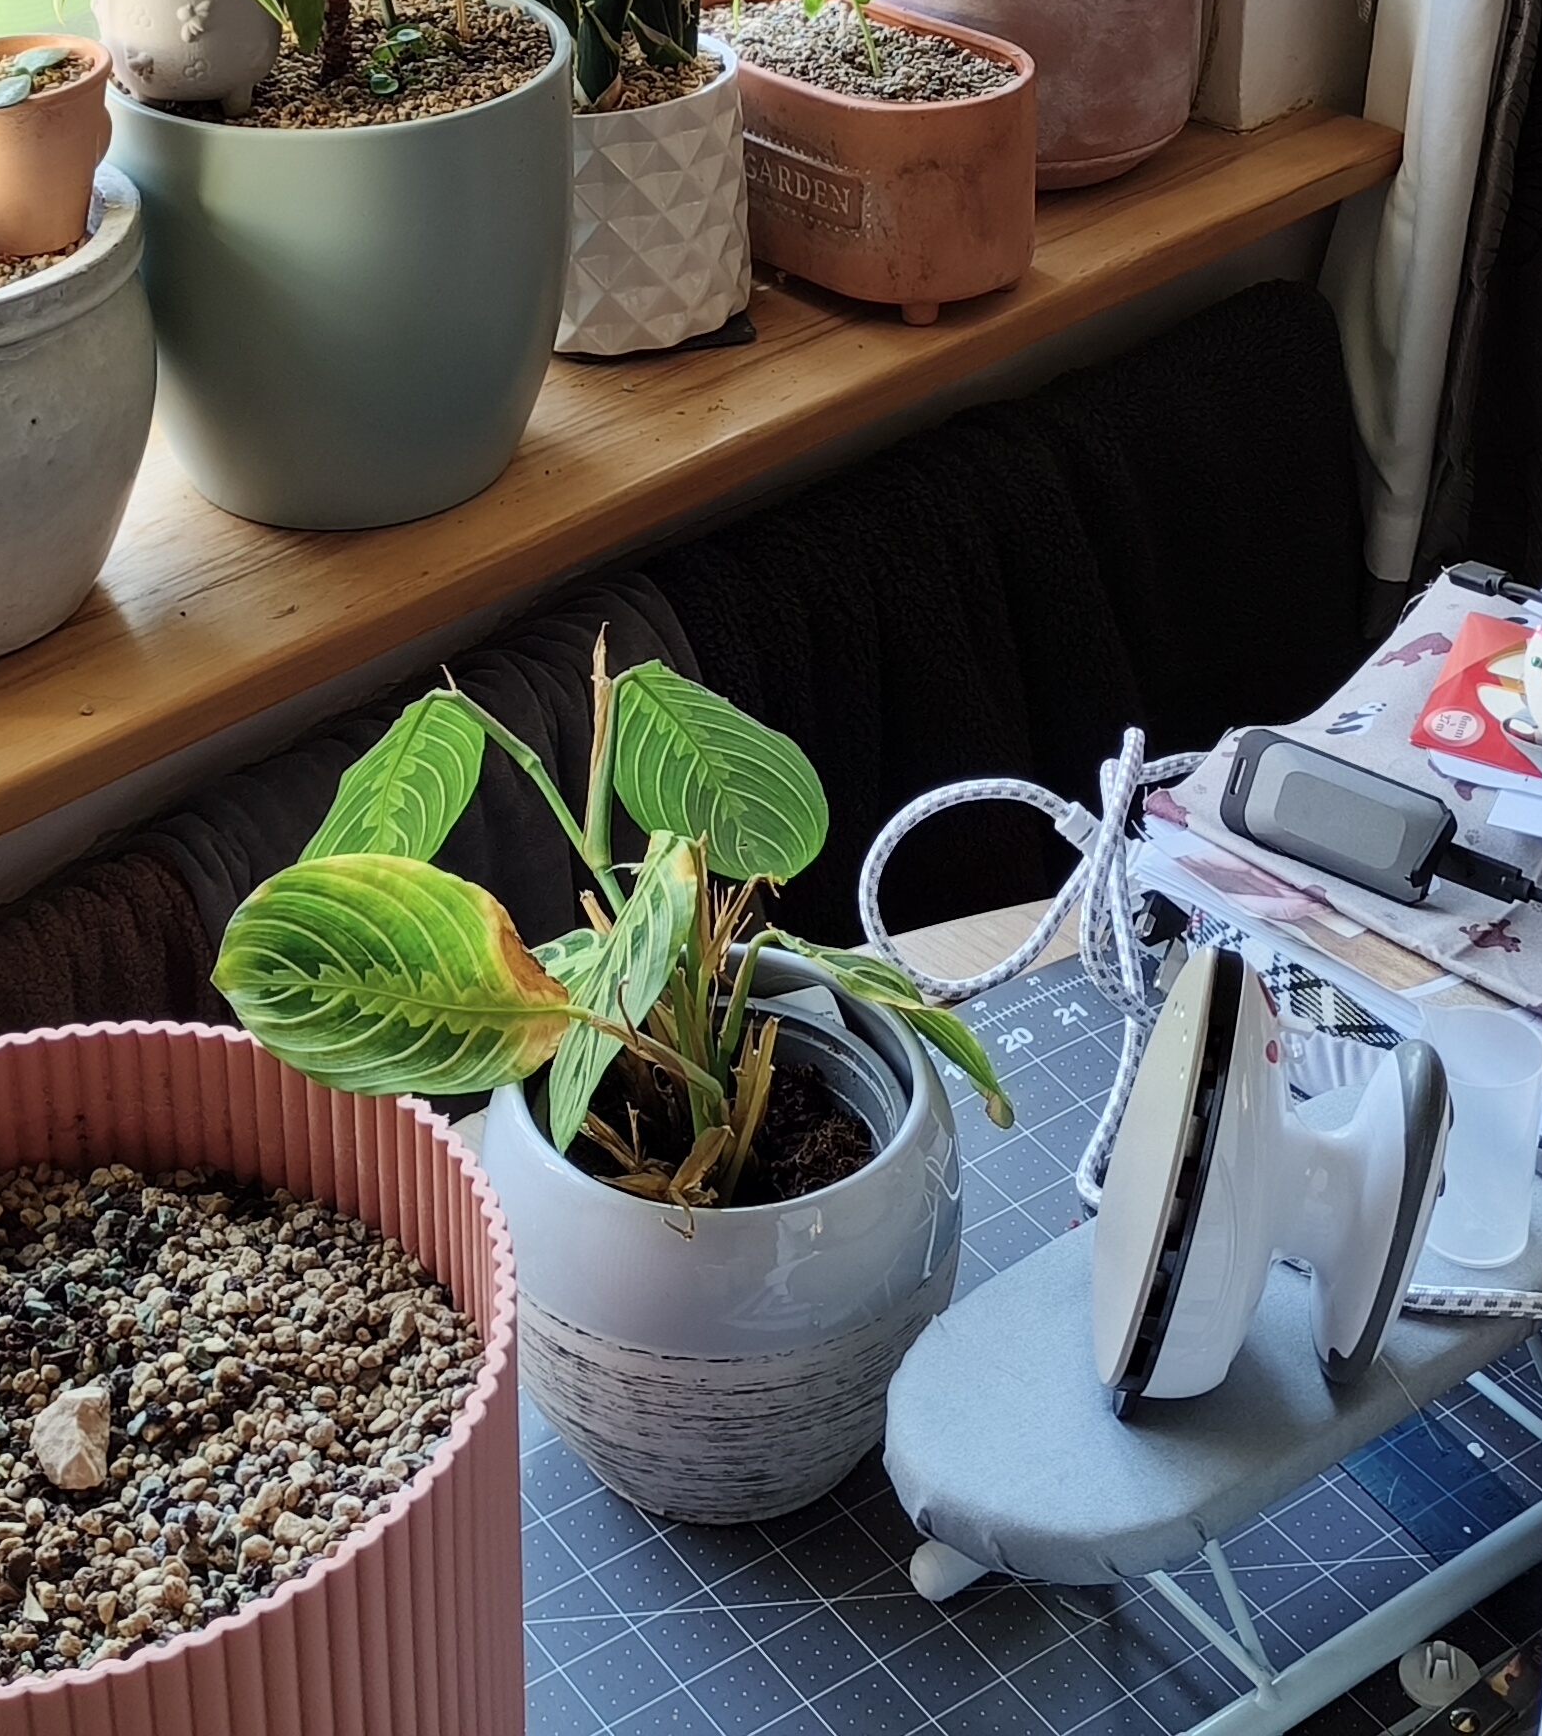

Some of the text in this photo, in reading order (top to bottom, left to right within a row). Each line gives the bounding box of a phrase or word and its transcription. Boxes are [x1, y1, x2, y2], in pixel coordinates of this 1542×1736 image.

[744, 151, 852, 216] GARDEN
[971, 975, 1042, 1012] 20 21
[996, 1027, 1035, 1054] 20
[1052, 1001, 1090, 1027] 21
